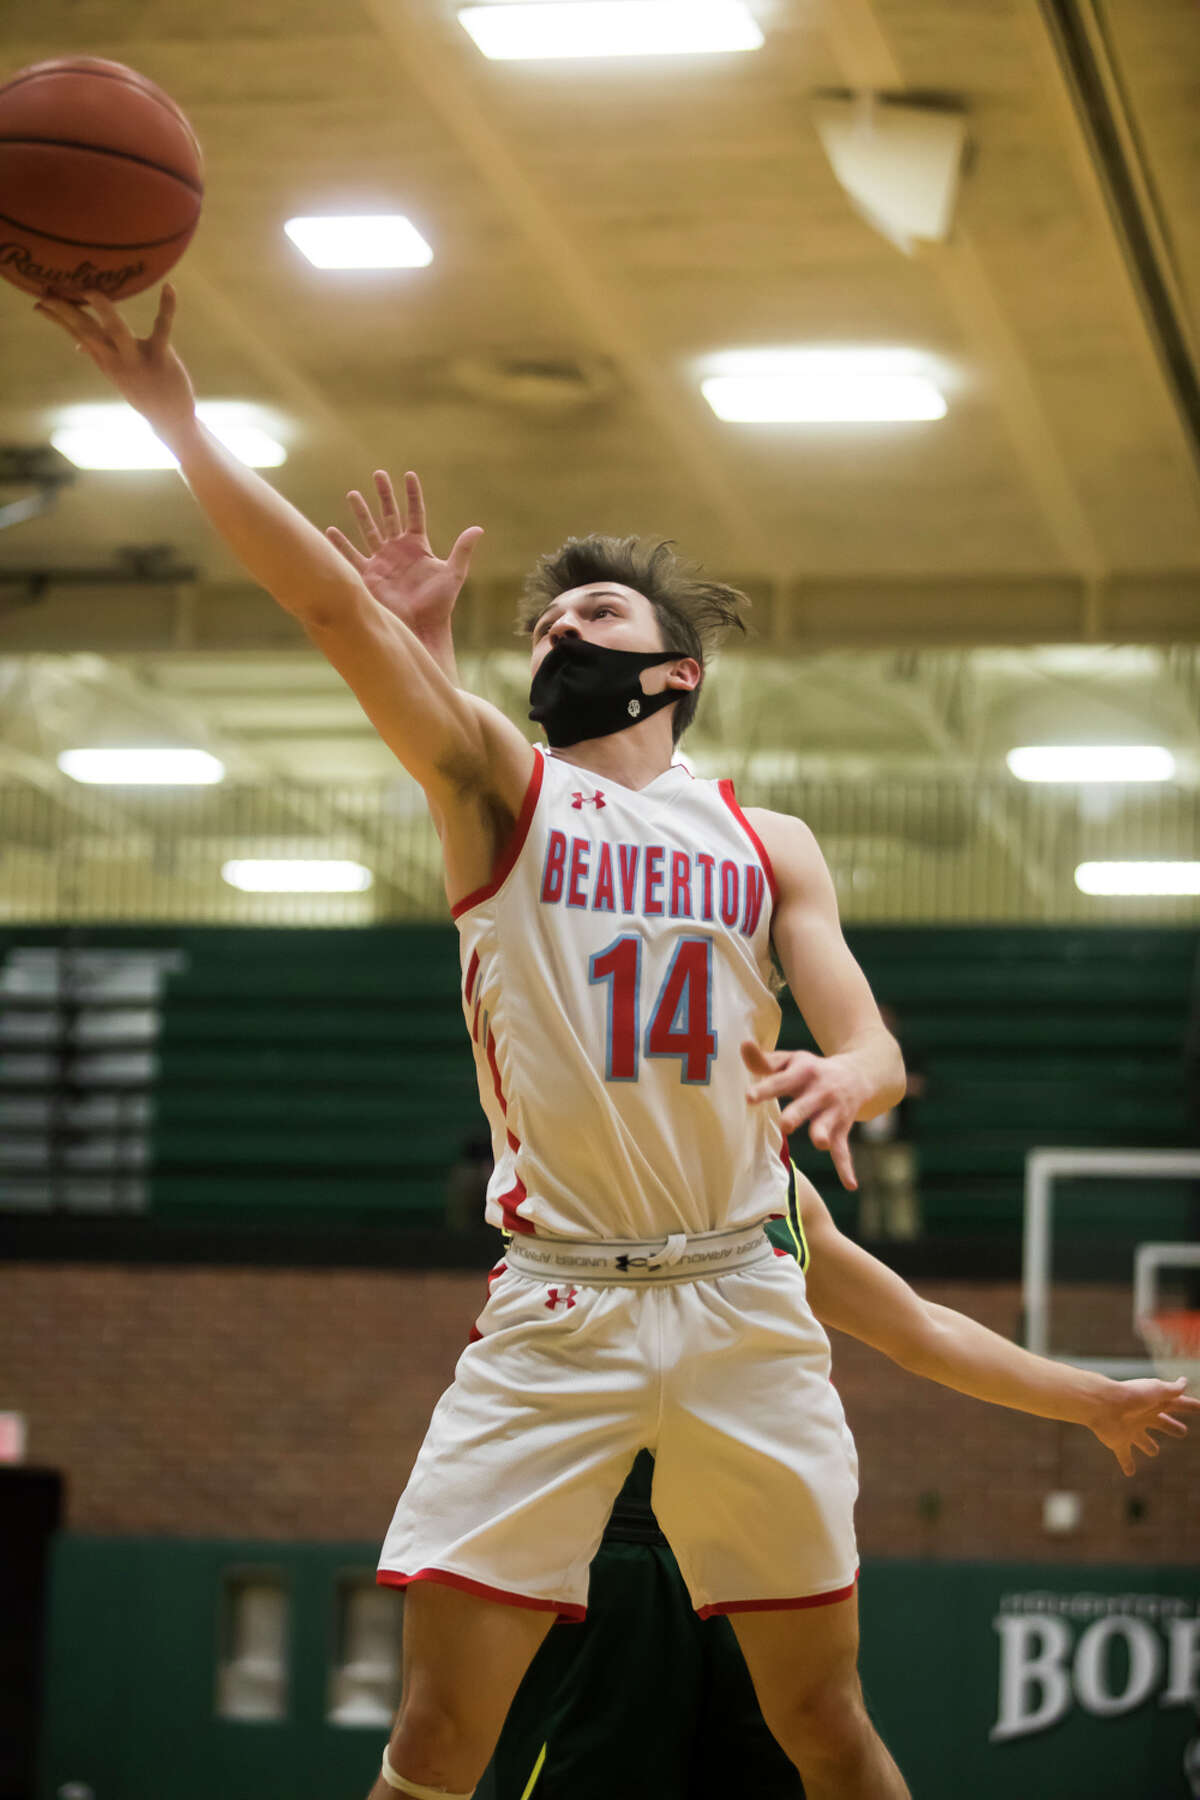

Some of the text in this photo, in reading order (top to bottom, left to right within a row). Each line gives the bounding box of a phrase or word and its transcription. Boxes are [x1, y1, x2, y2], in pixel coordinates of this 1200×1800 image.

[540, 828, 765, 938] BEAVERTON
[588, 933, 718, 1085] 14
[555, 1255, 607, 1268] UNDER
